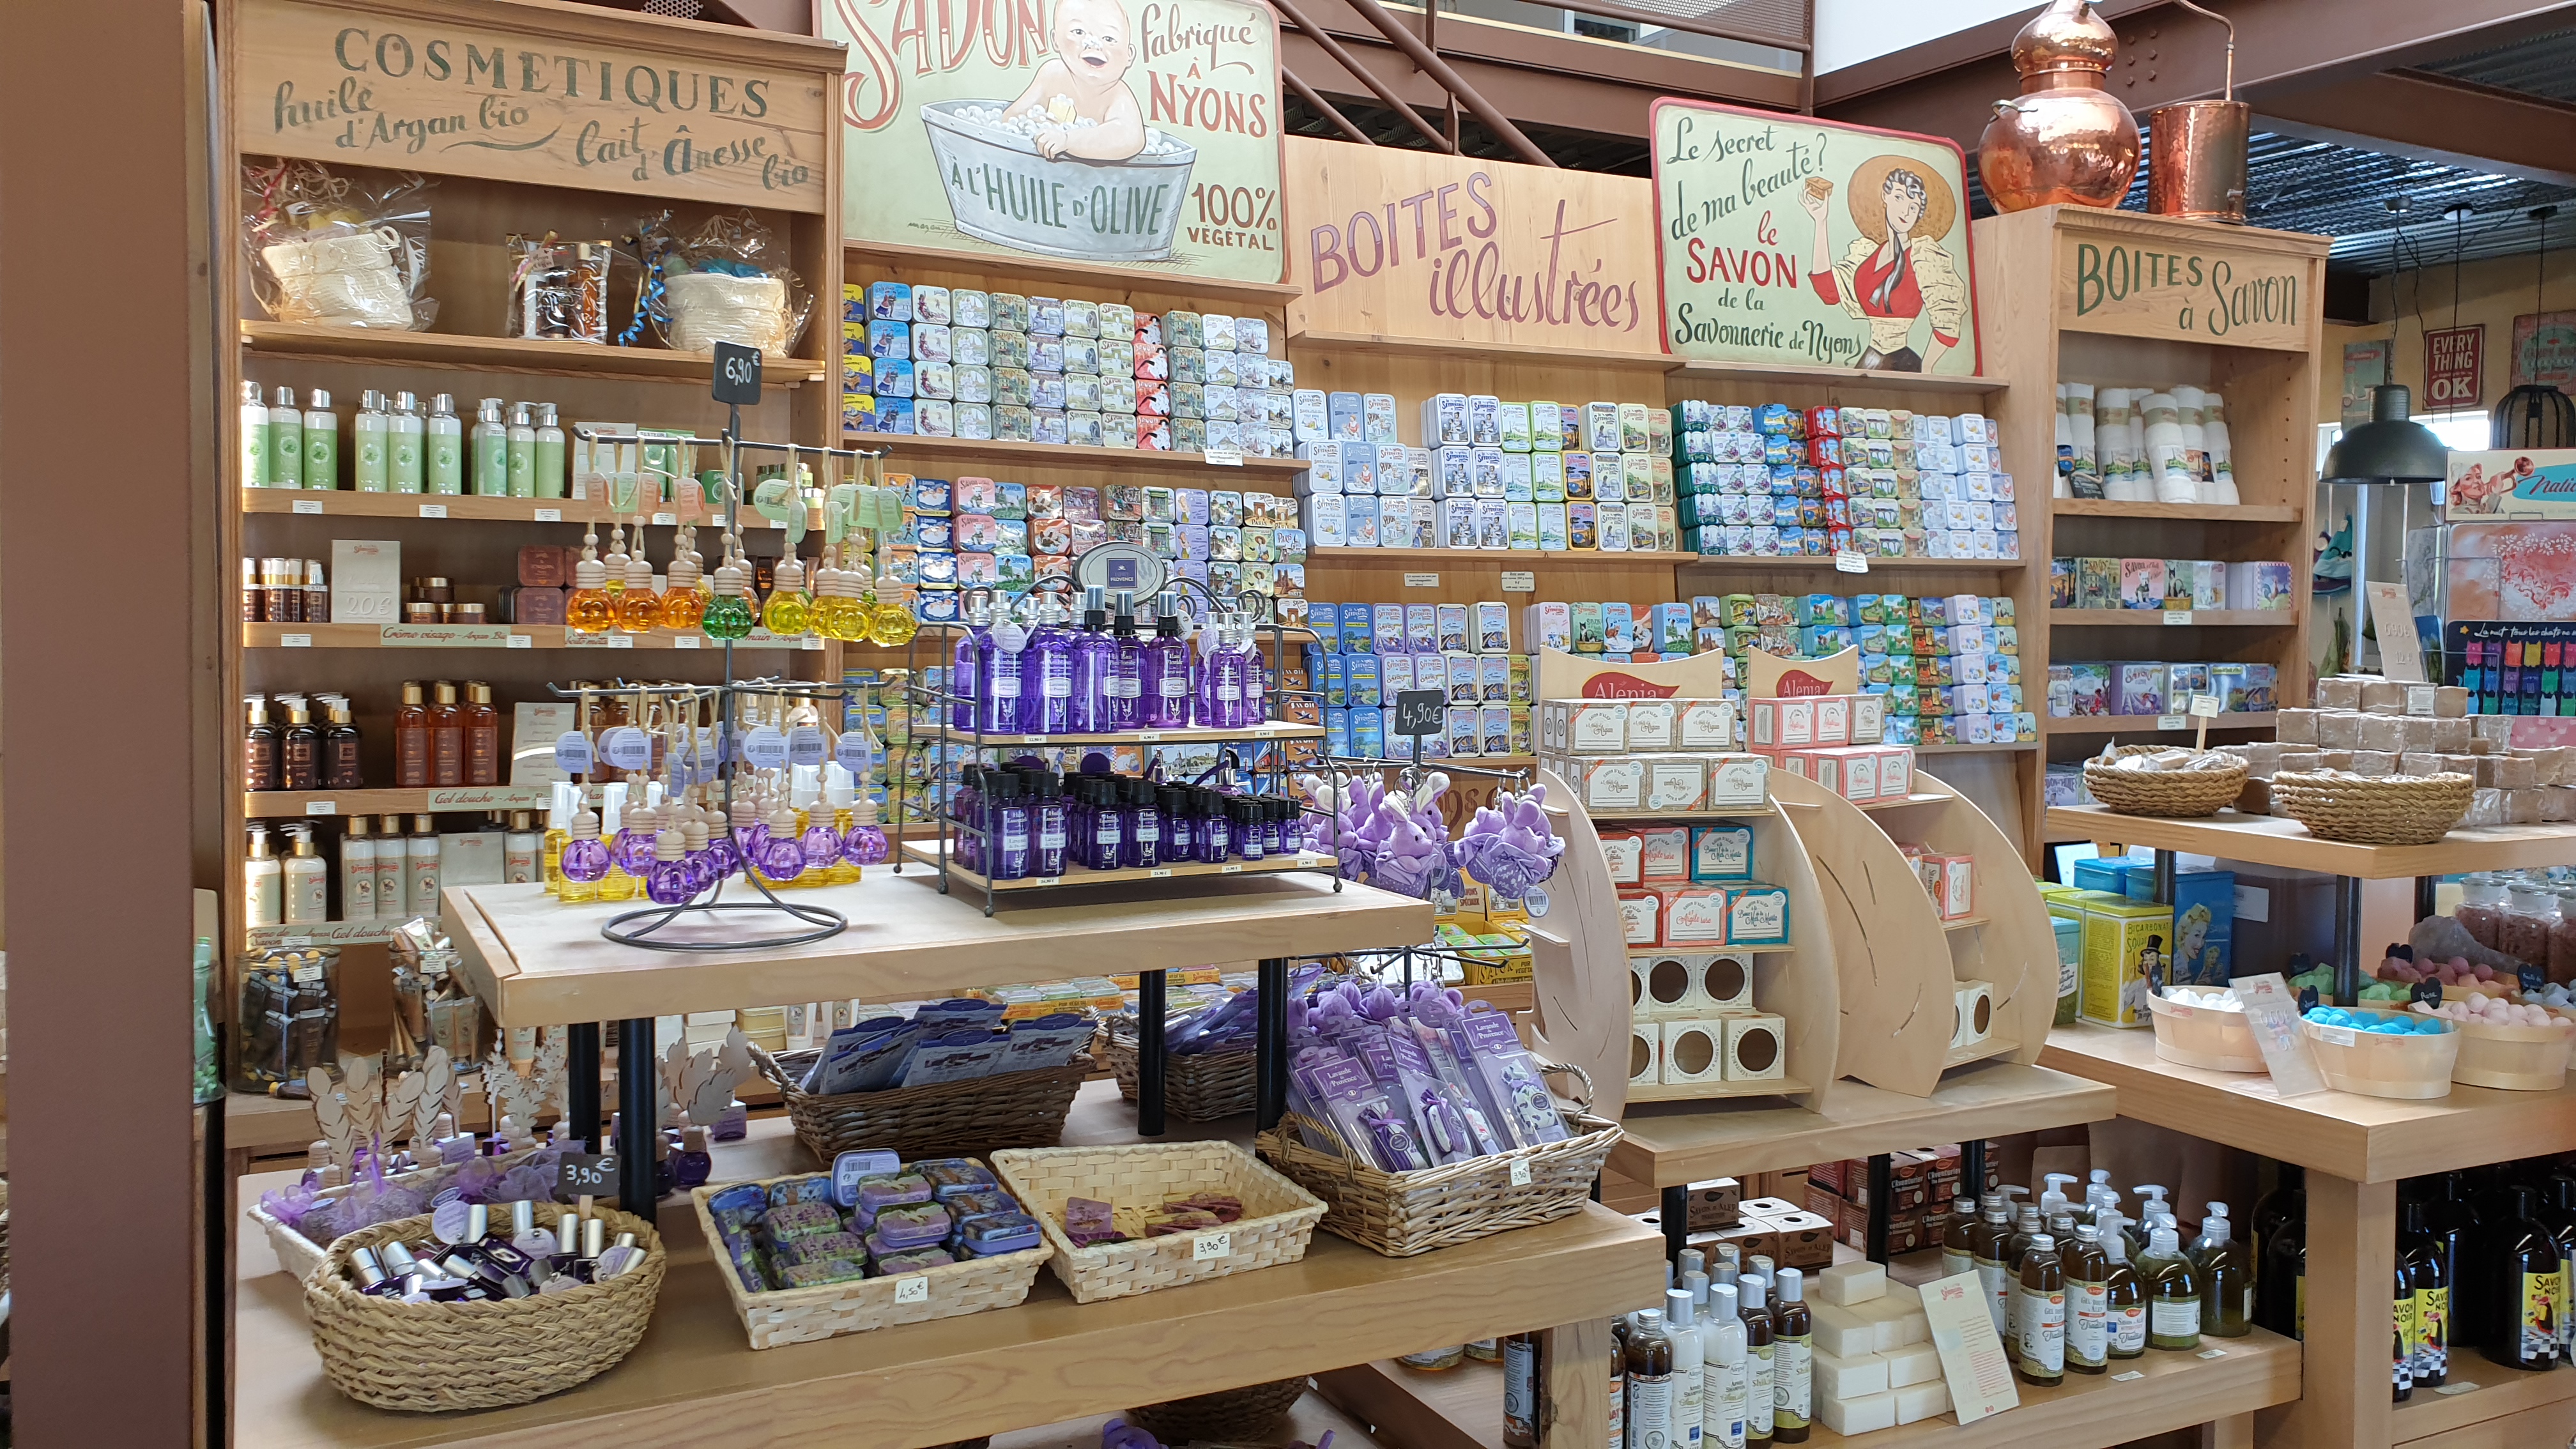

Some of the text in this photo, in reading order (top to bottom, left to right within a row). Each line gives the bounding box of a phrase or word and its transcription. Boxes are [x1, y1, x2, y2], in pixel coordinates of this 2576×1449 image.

[335, 27, 770, 119] COSMETIQUES
[273, 77, 376, 134] huile
[335, 94, 529, 153] d'Argan bio
[1149, 70, 1268, 138] NYONS
[576, 118, 650, 167] lait
[1666, 117, 1703, 166] Le
[762, 153, 810, 191] bio
[1192, 182, 1278, 231] 100%
[1671, 182, 1699, 241] de
[1701, 197, 1738, 229] ma
[1758, 210, 1779, 247] le
[1311, 172, 1497, 294] BOITES
[1429, 198, 1640, 332] illustrées
[1686, 236, 1798, 289] SAVON
[2077, 243, 2203, 316] BOITES
[1717, 287, 1766, 313] de la
[2178, 261, 2297, 337] à Savon
[1675, 302, 1863, 369] Savonnerie de Nyons
[2433, 333, 2475, 354] EVERY
[2434, 351, 2473, 371] THING
[2432, 376, 2473, 401] OK
[455, 792, 494, 803] douche
[2393, 1302, 2414, 1314] AVON
